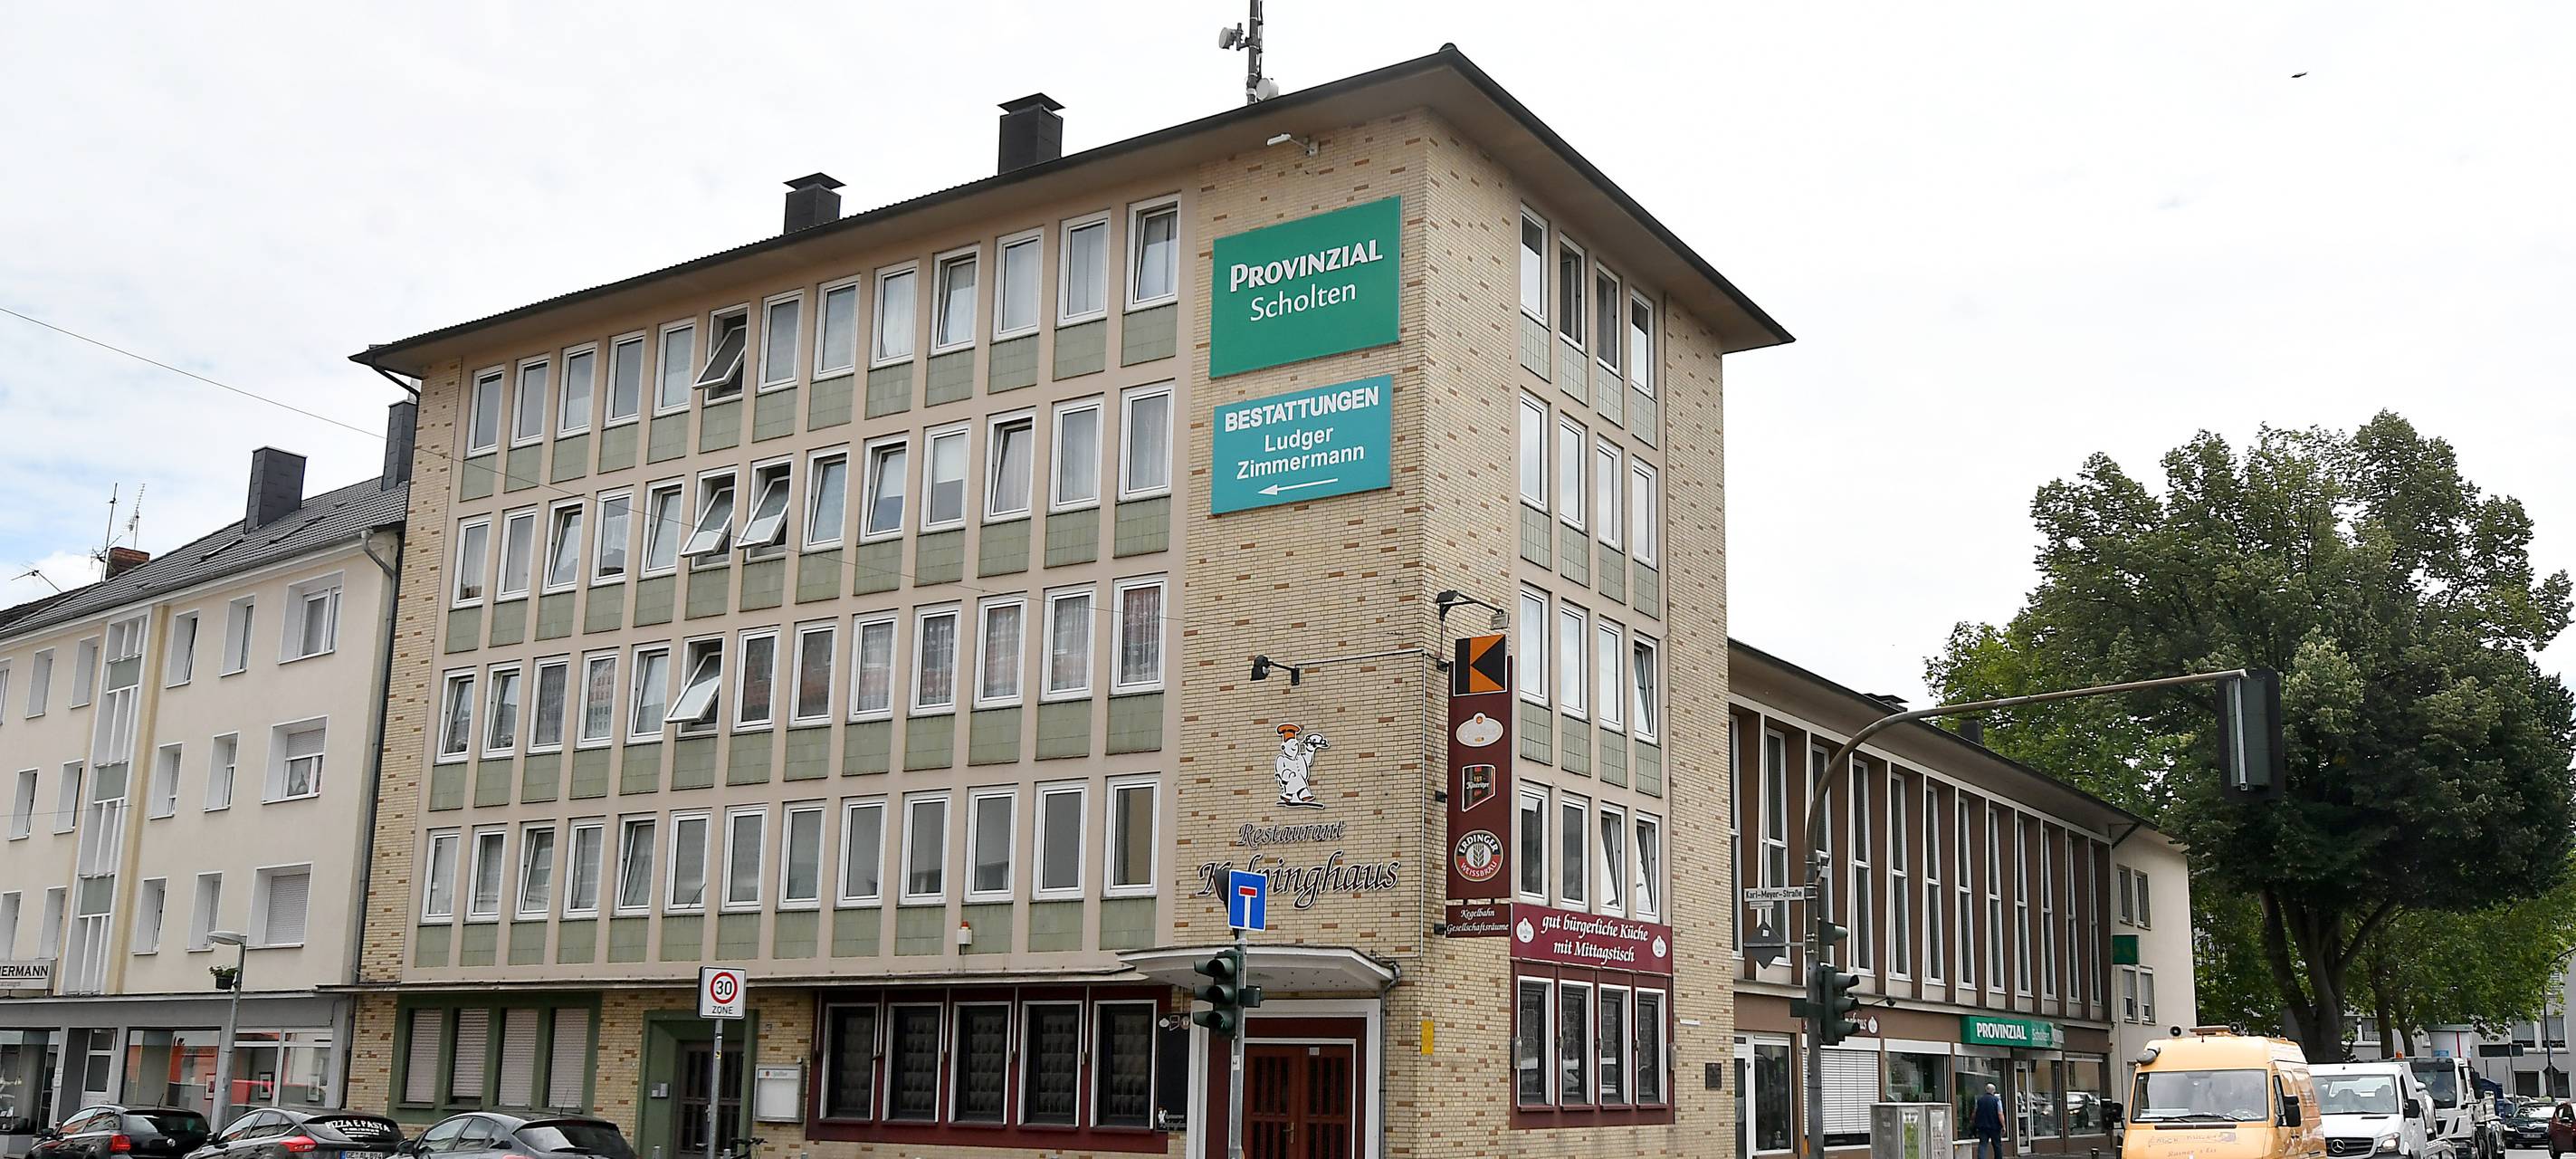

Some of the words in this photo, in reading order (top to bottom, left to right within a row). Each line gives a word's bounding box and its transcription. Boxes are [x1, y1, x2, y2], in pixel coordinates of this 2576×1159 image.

[1230, 239, 1383, 292] PROVINZIAL
[1250, 282, 1357, 321] Scholten
[1225, 386, 1379, 432] BESTATTUNGEN
[1264, 425, 1333, 453] Ludger
[1236, 444, 1365, 481] Zimmermann
[1236, 819, 1346, 849] Restaurant
[1458, 834, 1499, 854] ERDINGER
[1745, 889, 1803, 899] Karl-Meyer-Straße
[1460, 907, 1495, 920] Kegelbahn
[1446, 922, 1509, 934] Gesellschaftsräume
[1541, 915, 1561, 934] gut
[1563, 914, 1618, 939] bürgerliche
[1620, 924, 1649, 942] Küche
[1553, 939, 1572, 954] mit
[1574, 940, 1636, 965] Mittagstisch
[0, 965, 49, 977] ERMANN
[716, 981, 732, 995] 30
[711, 1005, 734, 1014] ZONE
[1976, 1022, 2027, 1040] PROVINZIAL
[325, 1120, 353, 1129] PIZZA
[353, 1119, 361, 1127] E
[361, 1120, 391, 1133] PASTA
